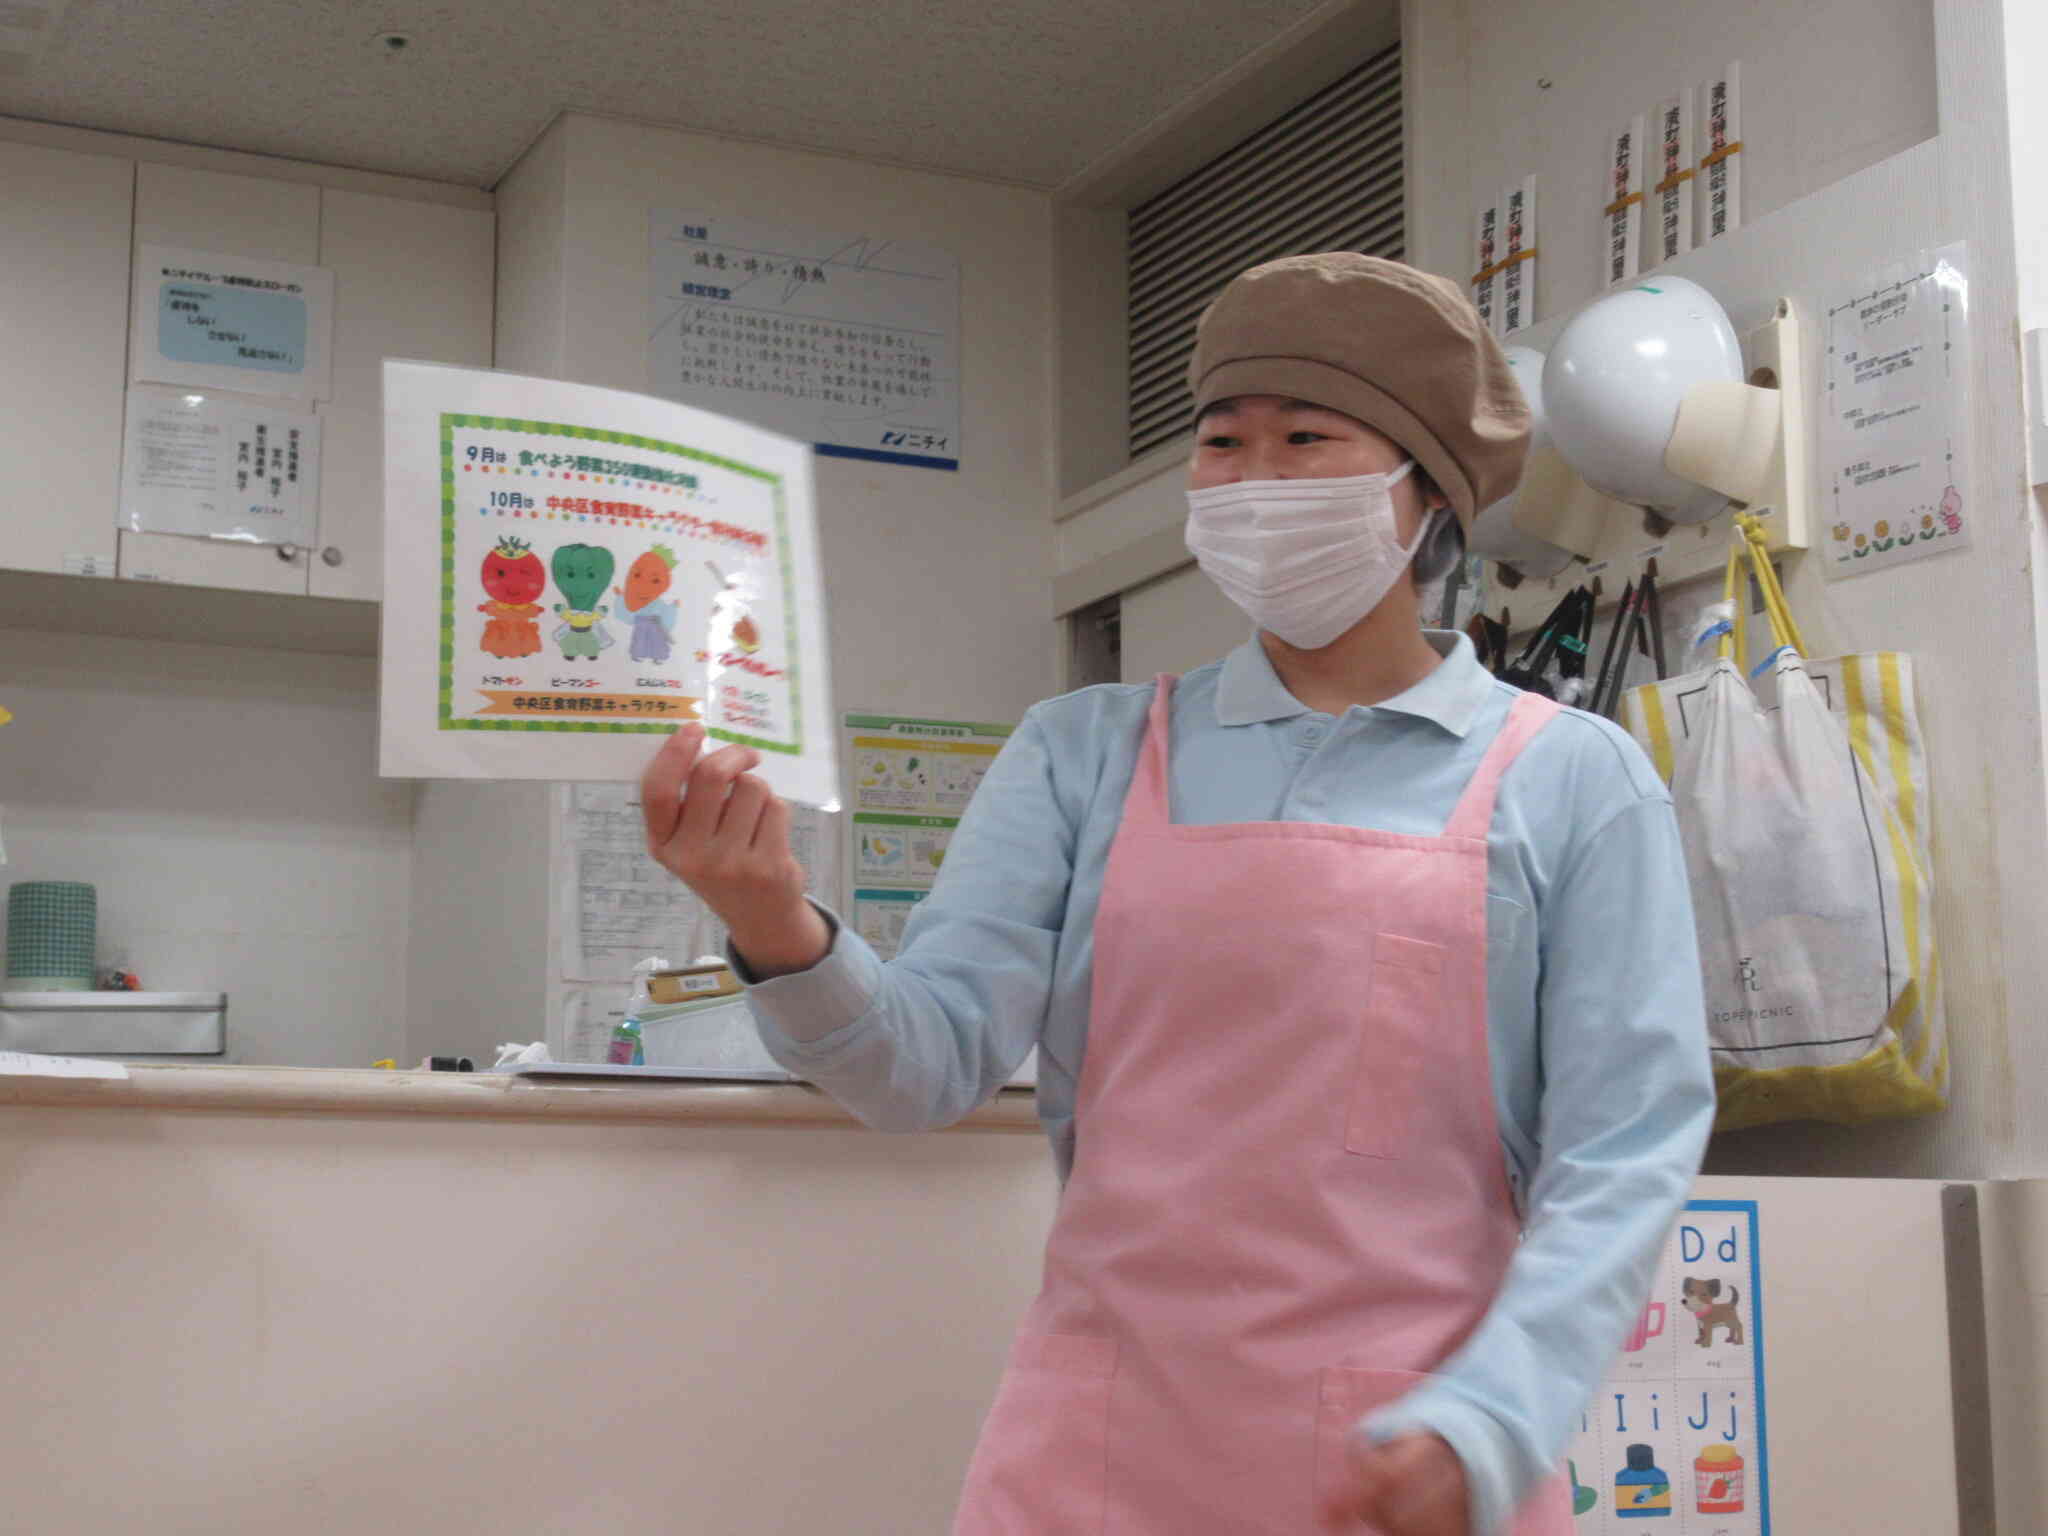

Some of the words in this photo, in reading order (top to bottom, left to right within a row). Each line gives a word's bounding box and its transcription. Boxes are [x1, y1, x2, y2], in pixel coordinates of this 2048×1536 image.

[466, 446, 507, 463] 9月は
[908, 434, 949, 452] ニチイ
[490, 491, 535, 508] 10月は
[1681, 1226, 1705, 1263] D
[1717, 1226, 1737, 1262] d
[1614, 1393, 1627, 1432] I
[1651, 1393, 1659, 1431] i
[1688, 1392, 1708, 1431] J
[1722, 1391, 1737, 1441] j
